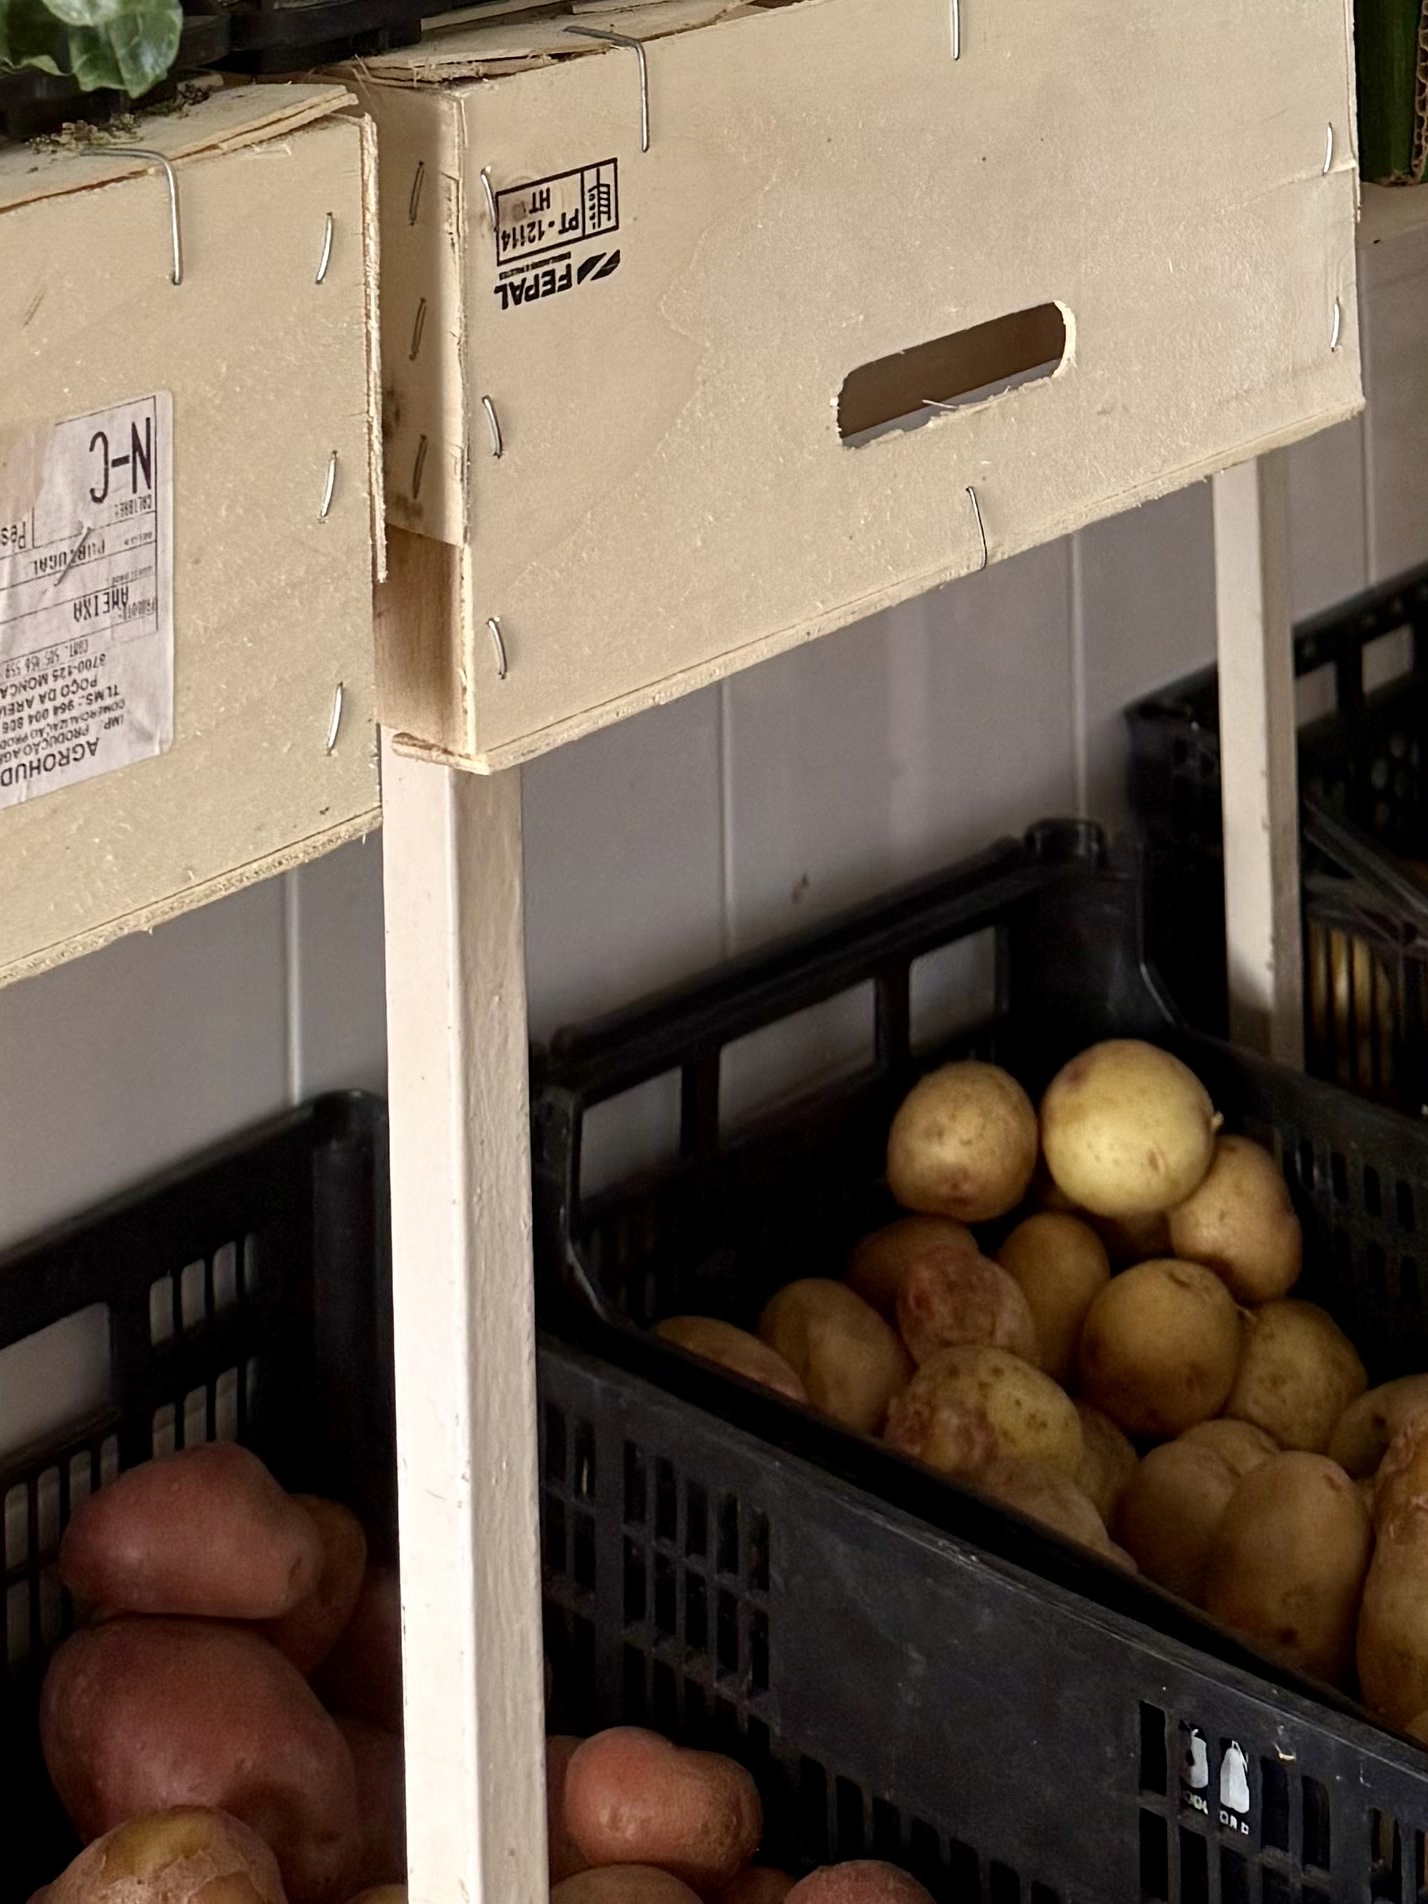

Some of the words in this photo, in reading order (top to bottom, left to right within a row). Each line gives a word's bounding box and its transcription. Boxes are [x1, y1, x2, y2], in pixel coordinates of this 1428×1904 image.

[528, 187, 551, 214] HT
[501, 219, 545, 252] 12114
[558, 208, 579, 235] PT
[494, 263, 572, 310] FEPAL
[89, 416, 151, 506] N-C
[73, 585, 128, 623] AMEIXA
[37, 688, 55, 705] DA
[60, 672, 97, 698] POÇO
[23, 724, 88, 759] PRODUÇÃO
